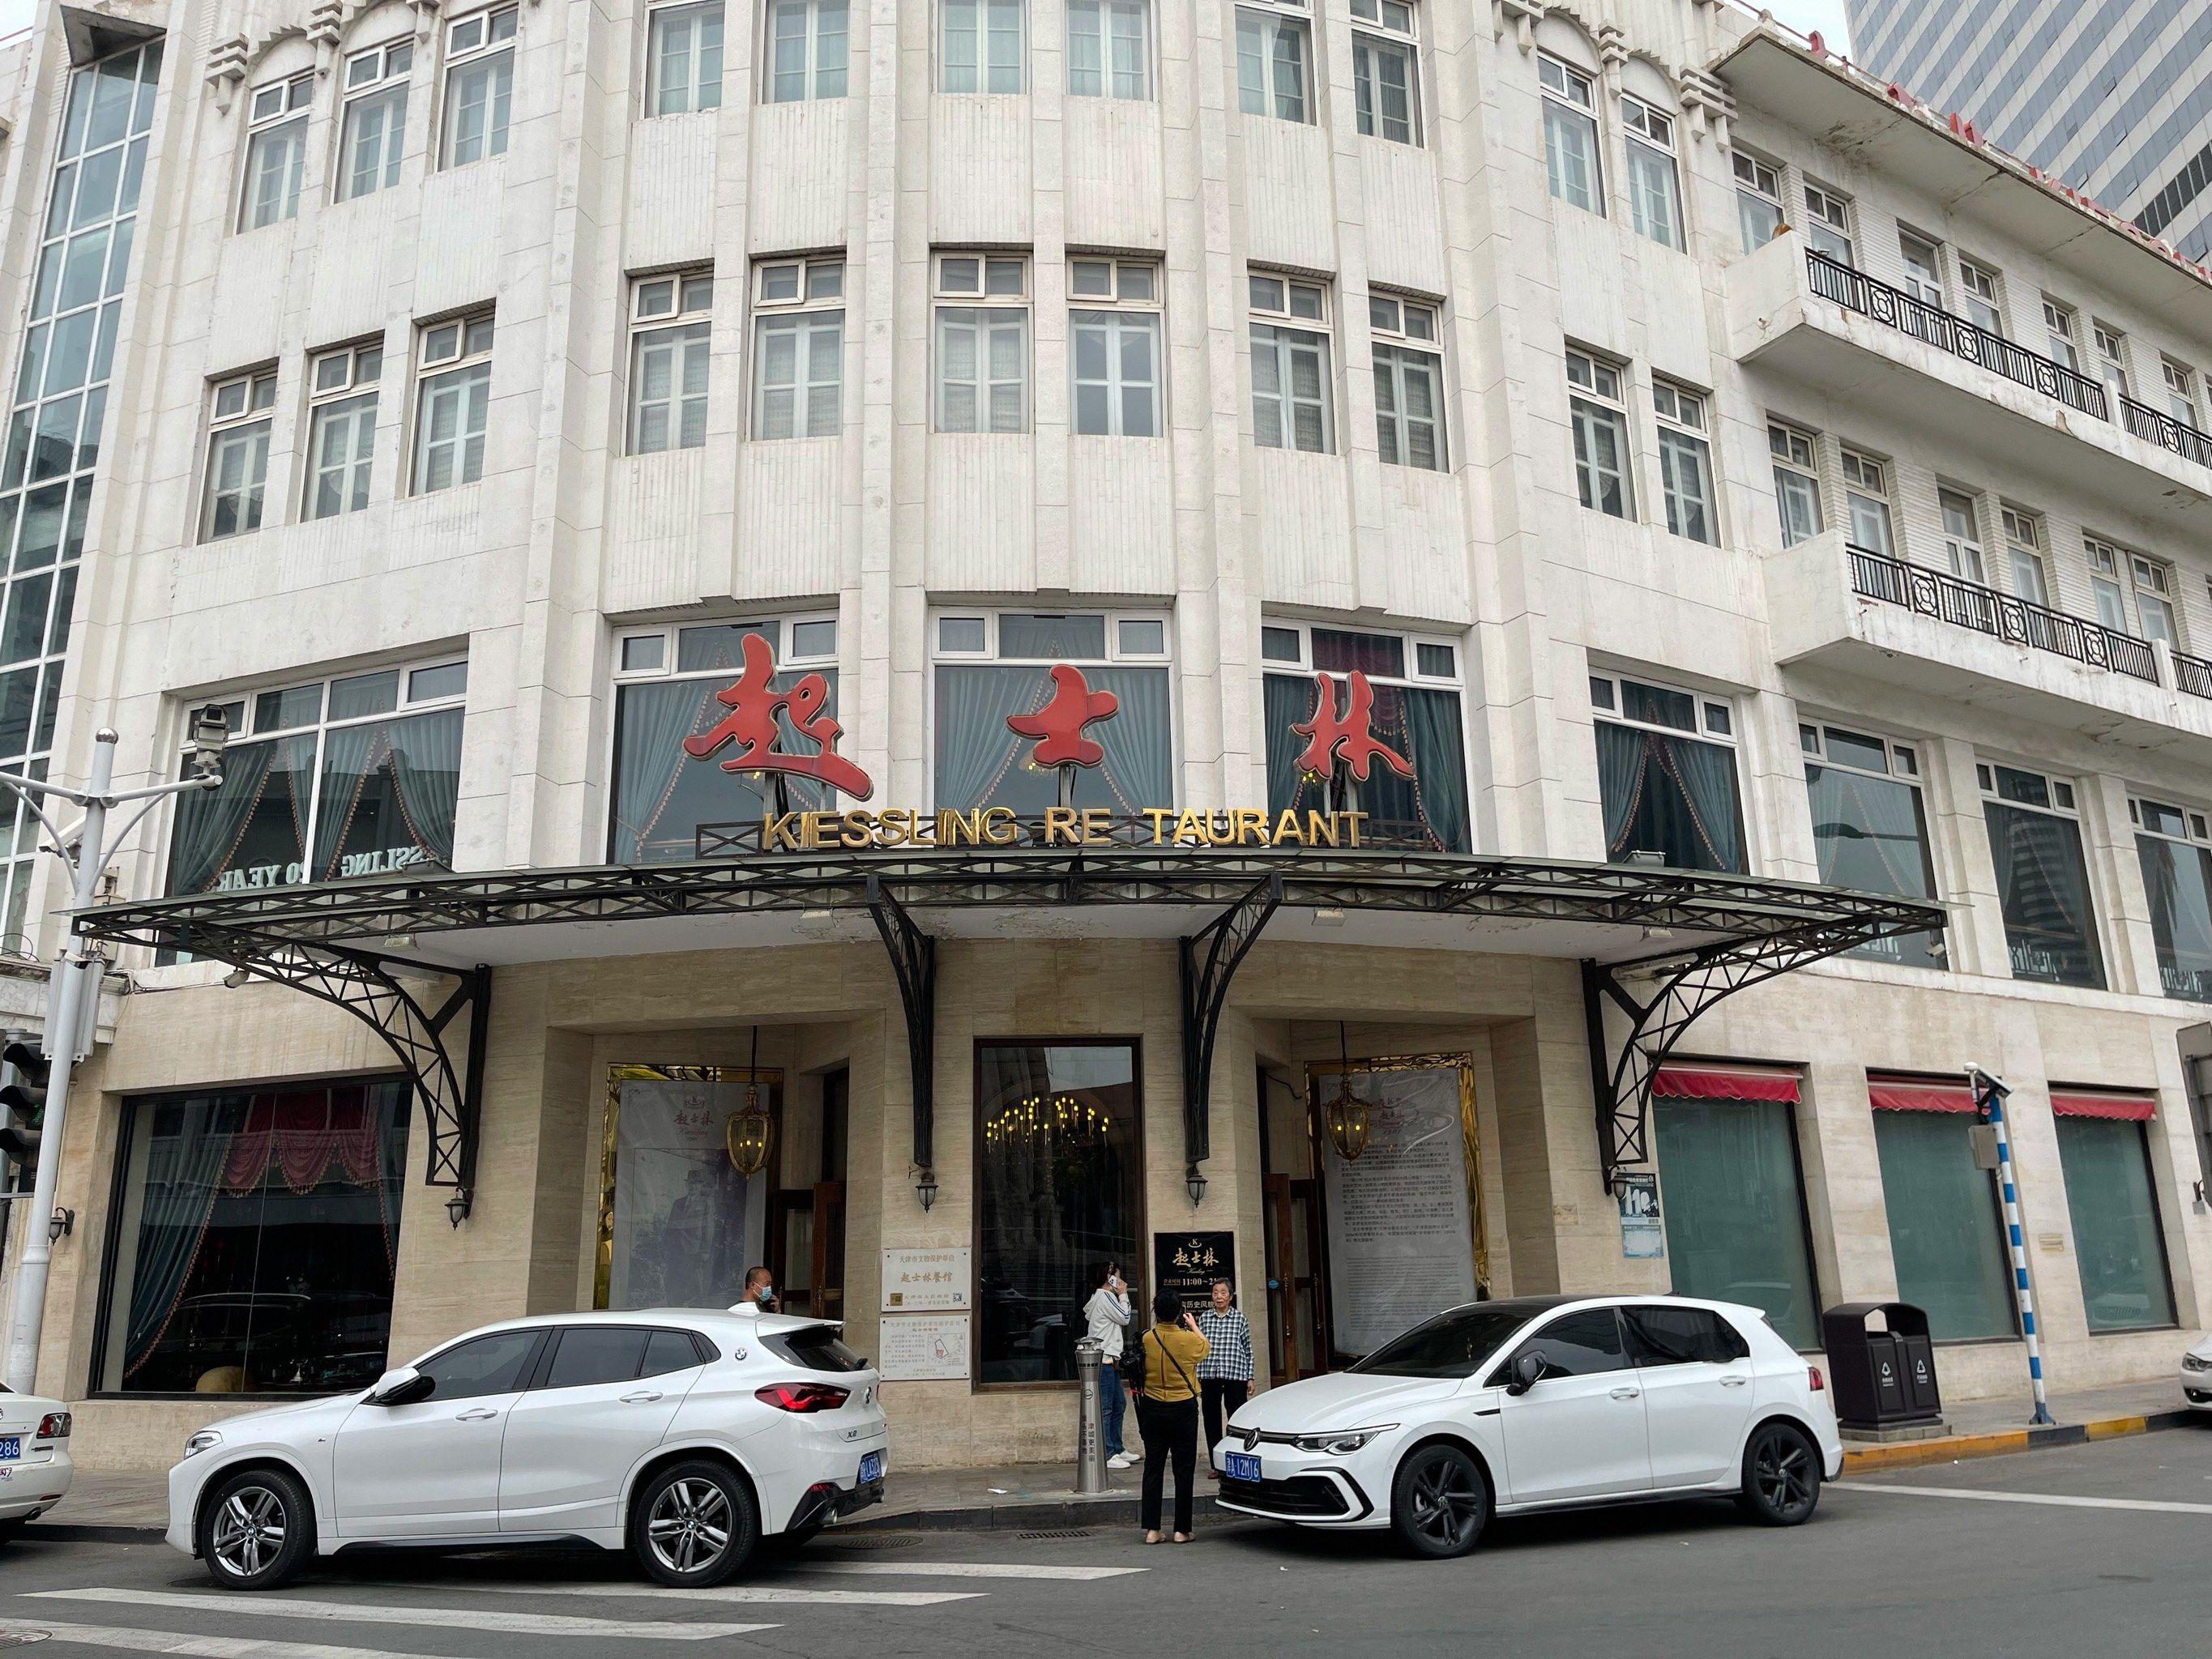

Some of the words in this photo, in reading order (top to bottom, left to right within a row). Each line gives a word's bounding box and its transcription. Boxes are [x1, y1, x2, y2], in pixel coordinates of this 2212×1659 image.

[762, 807, 1018, 851] KIESSLING
[1044, 807, 1111, 846] RE
[1143, 808, 1369, 849] TAURANT
